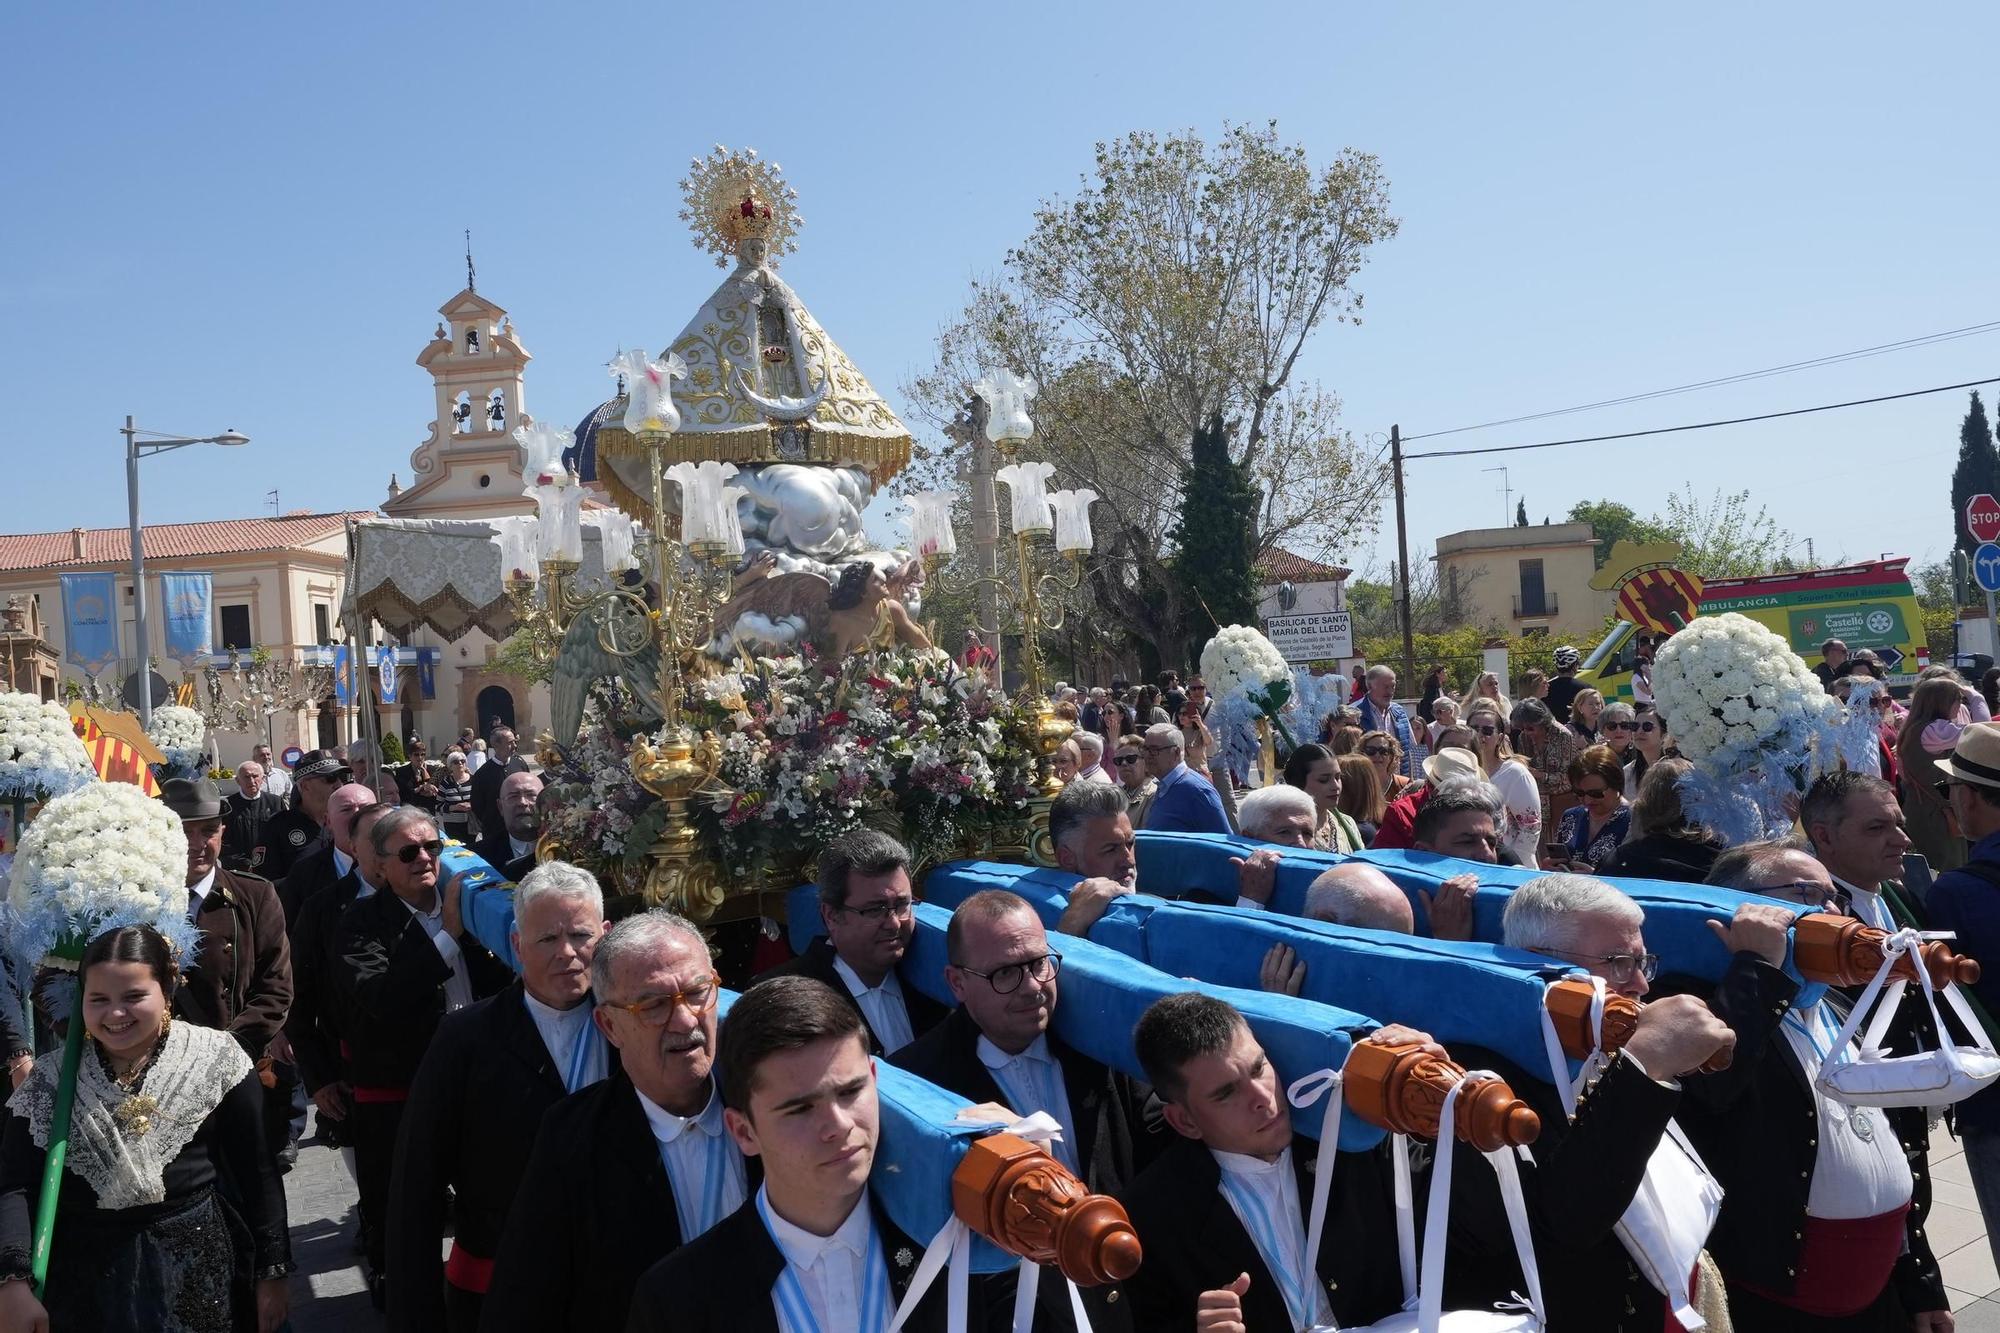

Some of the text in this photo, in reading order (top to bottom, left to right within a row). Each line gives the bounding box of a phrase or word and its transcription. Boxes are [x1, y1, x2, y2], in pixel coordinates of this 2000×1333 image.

[1972, 512, 1999, 524] STOP
[1697, 598, 1779, 612] MBULANCIA
[1269, 615, 1349, 628] BASÍLICA DE SANTA
[1825, 617, 1864, 627] Castelló
[1272, 623, 1347, 637] MARÍA DEL LLEDÓ
